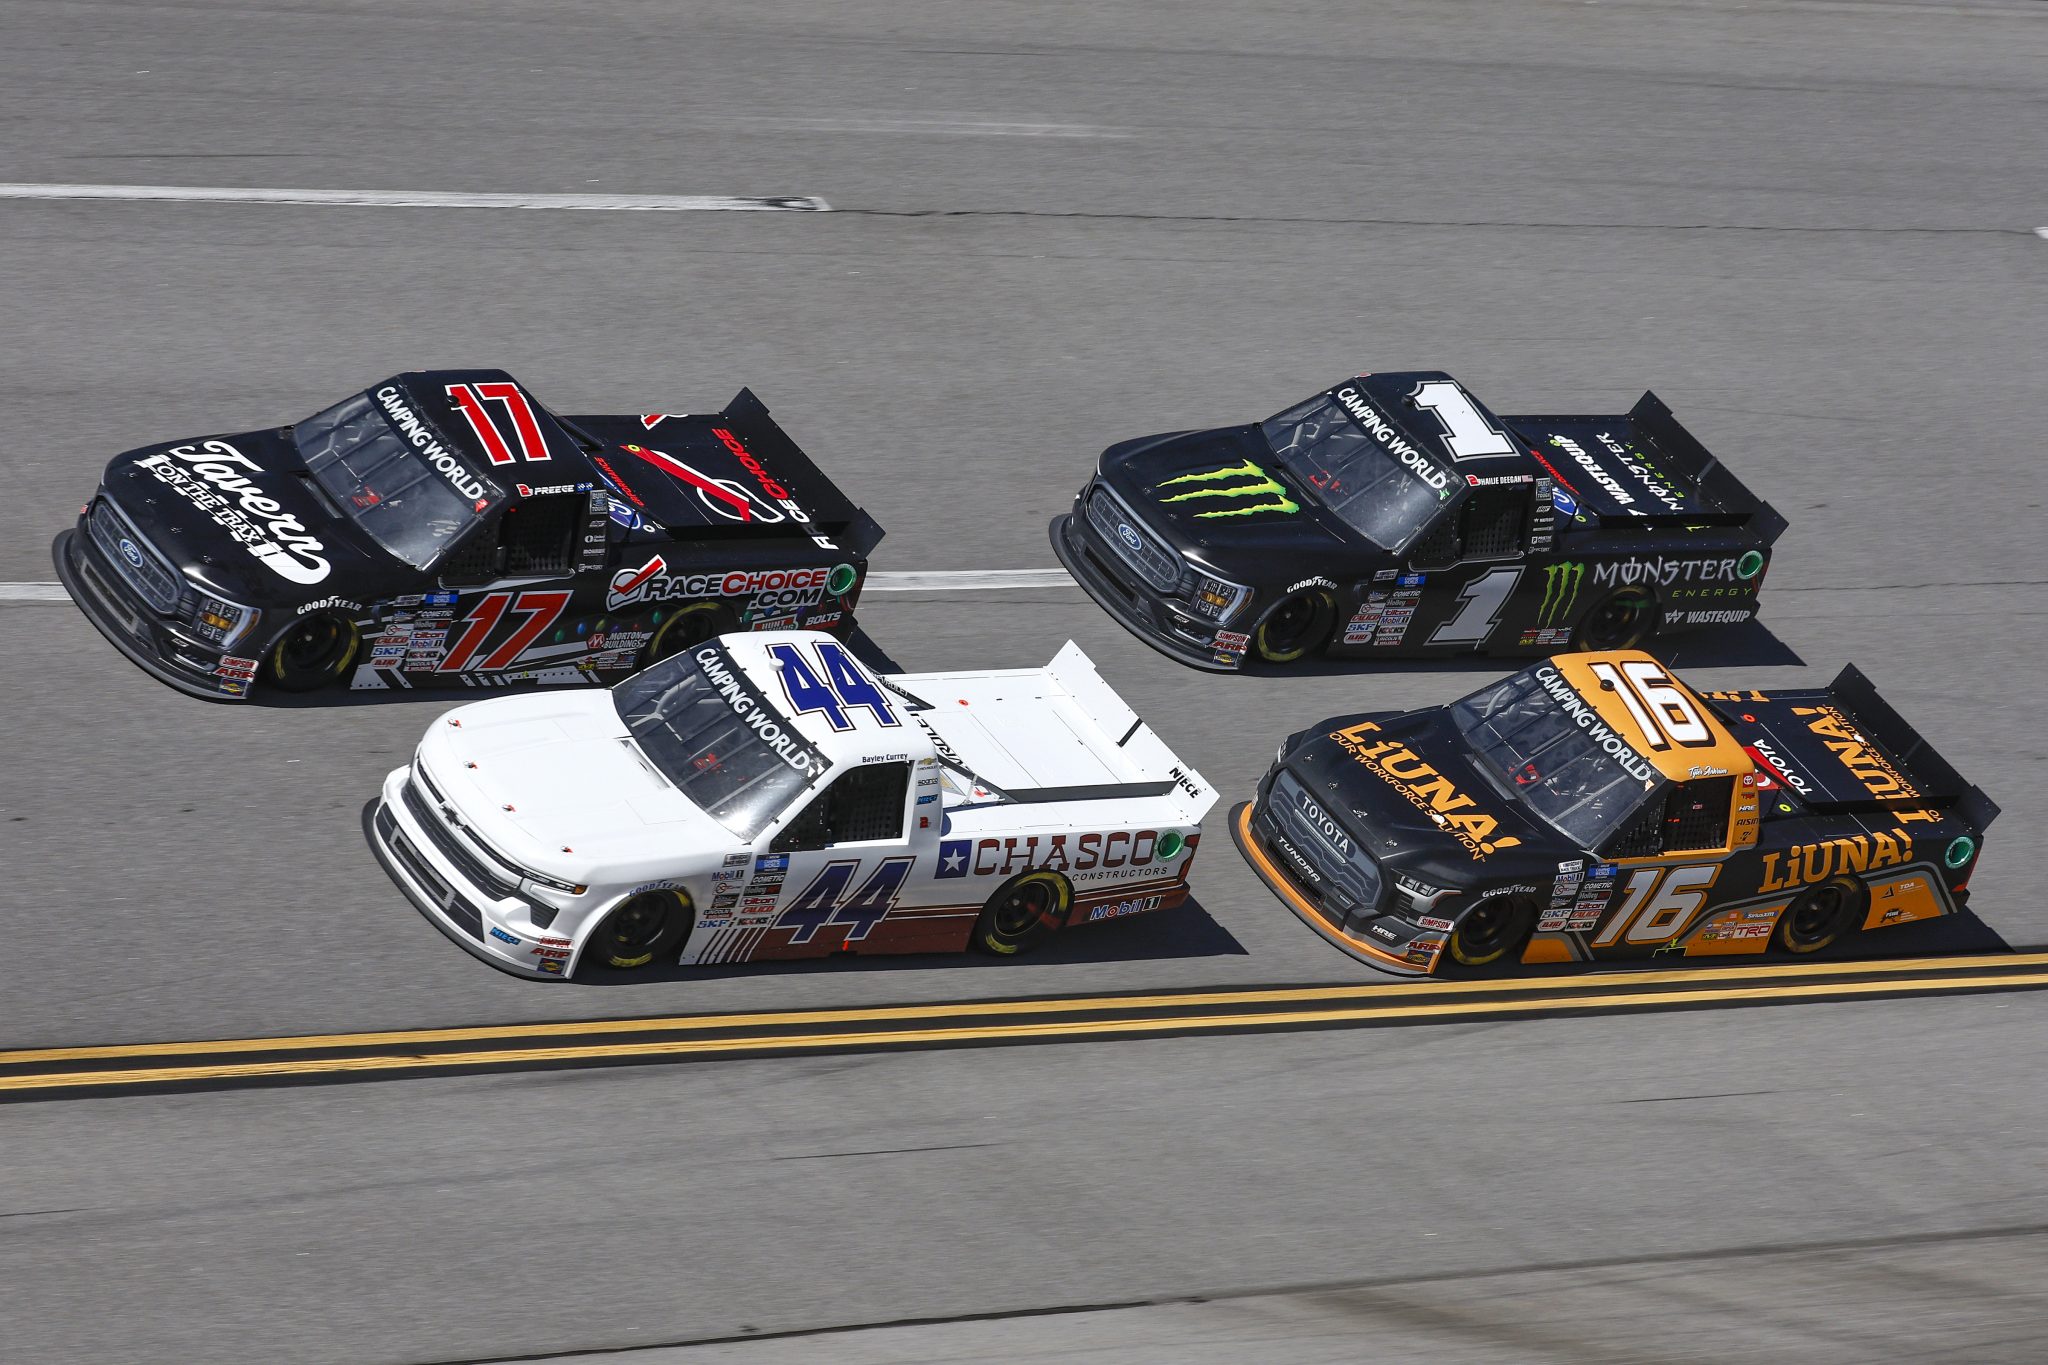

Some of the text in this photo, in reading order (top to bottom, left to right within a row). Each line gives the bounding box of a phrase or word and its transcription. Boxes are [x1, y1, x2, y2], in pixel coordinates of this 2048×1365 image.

[444, 382, 552, 466] 17
[1407, 379, 1521, 463] 1
[376, 386, 486, 501] CAMPING WORLD
[1337, 387, 1447, 490] CAMPING WORLD
[1553, 434, 1635, 505] WASTEQUIP
[1624, 441, 1685, 498] ENERGY
[1500, 475, 1522, 484] DEEGAN
[156, 464, 262, 542] ON THE TRAX
[168, 440, 331, 585] Tavern
[1119, 526, 1140, 547] Ford
[122, 540, 141, 565] Ford
[645, 567, 828, 600] RACECHOICE
[1286, 575, 1338, 594] GOODYEAR
[1392, 590, 1421, 598] COMETIC
[1671, 588, 1753, 598] ENERGY
[297, 594, 362, 616] GOODYEAR
[421, 610, 454, 618] COMETIC
[1422, 565, 1527, 646] 1
[805, 612, 842, 626] BOLTS
[1686, 610, 1750, 624] WASTEQUIP
[437, 590, 574, 674] 17
[1347, 623, 1376, 631] SKF
[410, 640, 434, 648] Mobil
[602, 639, 642, 649] BUILDINGS
[609, 632, 642, 641] MORTON
[1217, 631, 1248, 643] SIMPSON
[373, 647, 405, 656] SKF
[1211, 641, 1248, 652] ARP
[222, 656, 256, 670] SIMPSON
[214, 668, 255, 681] ARP
[765, 641, 902, 733] 44
[695, 648, 755, 715] CAMPING
[744, 706, 810, 772] WORLD
[1588, 660, 1716, 751] 16
[1535, 666, 1596, 728] CAMPING
[1588, 721, 1651, 782] WORLD
[862, 752, 909, 764] Bayley Currey
[1752, 738, 1813, 796] TOYOTA
[1863, 744, 1921, 798] WORKFORCE
[1169, 767, 1199, 798] NIECE
[1337, 721, 1522, 855] LiUNA!
[1329, 732, 1486, 862] OUR WORKFORCE SOLUTION
[1738, 804, 1757, 813] HRE
[1301, 795, 1350, 853] TOYOTA
[973, 830, 1158, 876] CHASCO
[1278, 835, 1321, 883] TUNDRA
[1757, 828, 1914, 893] LiUNA!
[712, 870, 735, 881] Mobil
[752, 875, 784, 883] COMETIC
[1072, 866, 1168, 882] CONSTRUCTORS
[1557, 874, 1576, 883] Mobil
[629, 879, 687, 897] GOODYEAR
[1482, 884, 1537, 898] GOODYEAR
[744, 897, 775, 905] tilton
[770, 855, 917, 944] 44
[1591, 862, 1723, 948] 16
[741, 906, 776, 914] CALICO
[1090, 900, 1142, 921] Mobil
[1542, 909, 1572, 918] SKF
[696, 919, 730, 929] SKF
[1372, 924, 1397, 940] HRE
[1419, 917, 1451, 930] SIMPSON
[1736, 925, 1772, 938] TRD
[530, 948, 570, 958] ARP
[1407, 941, 1441, 951] ARP
